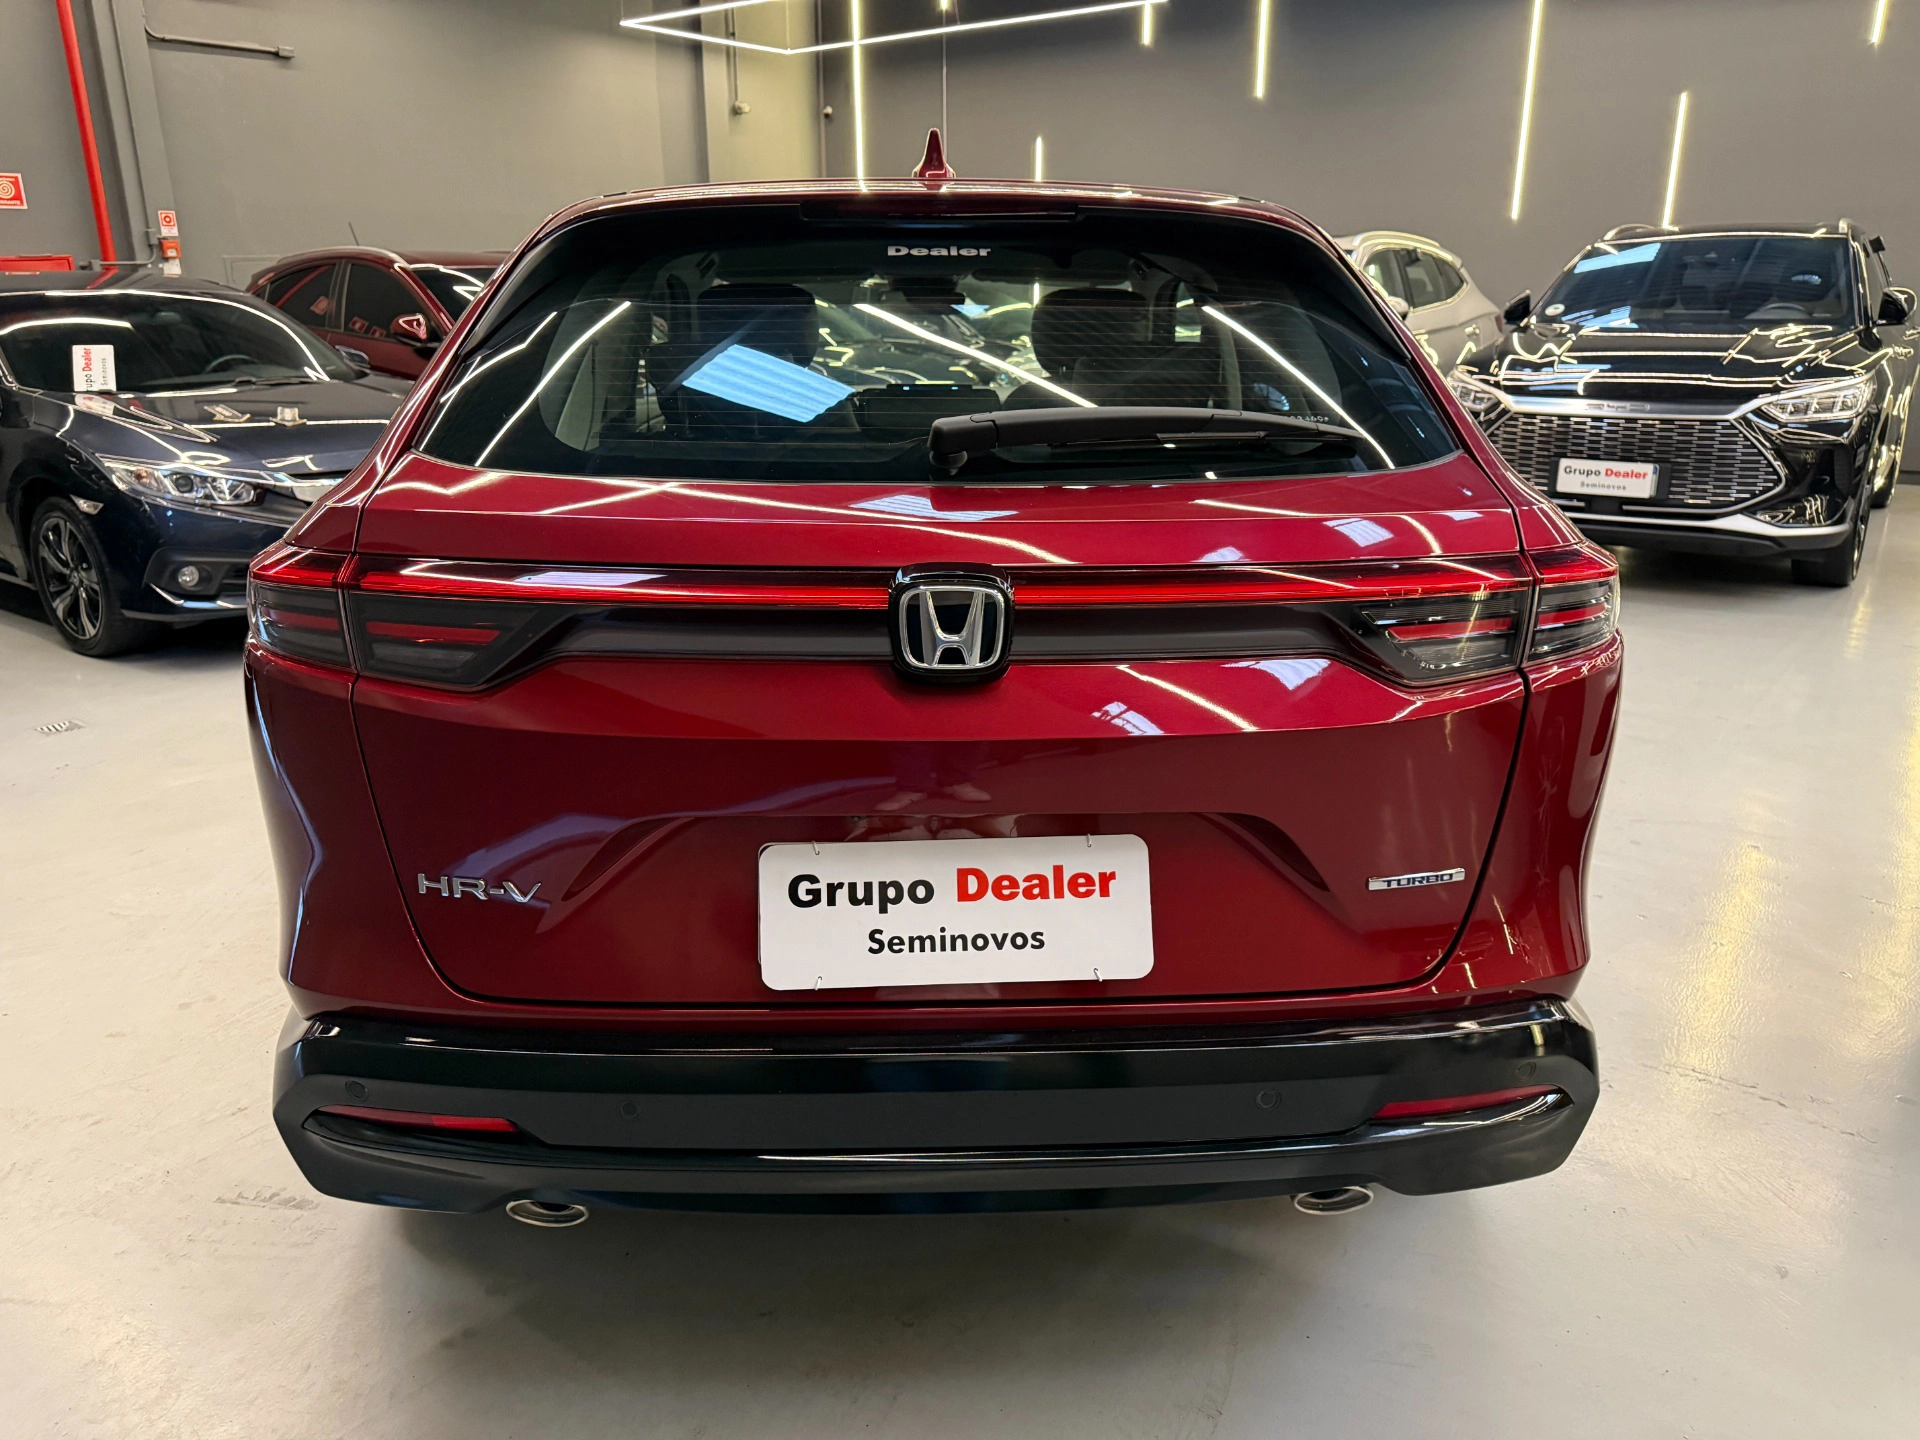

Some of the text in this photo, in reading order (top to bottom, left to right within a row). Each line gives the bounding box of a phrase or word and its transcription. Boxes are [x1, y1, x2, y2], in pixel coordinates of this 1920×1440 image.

[887, 245, 992, 257] Dealer
[82, 347, 93, 372] Dealer
[1563, 465, 1648, 480] Grupo Dealer
[1579, 480, 1627, 491] Seminovos
[417, 872, 542, 903] HR-V
[787, 864, 1117, 915] Grupo Dealer
[1382, 872, 1454, 888] TURBO
[867, 926, 1046, 955] Seminovos
